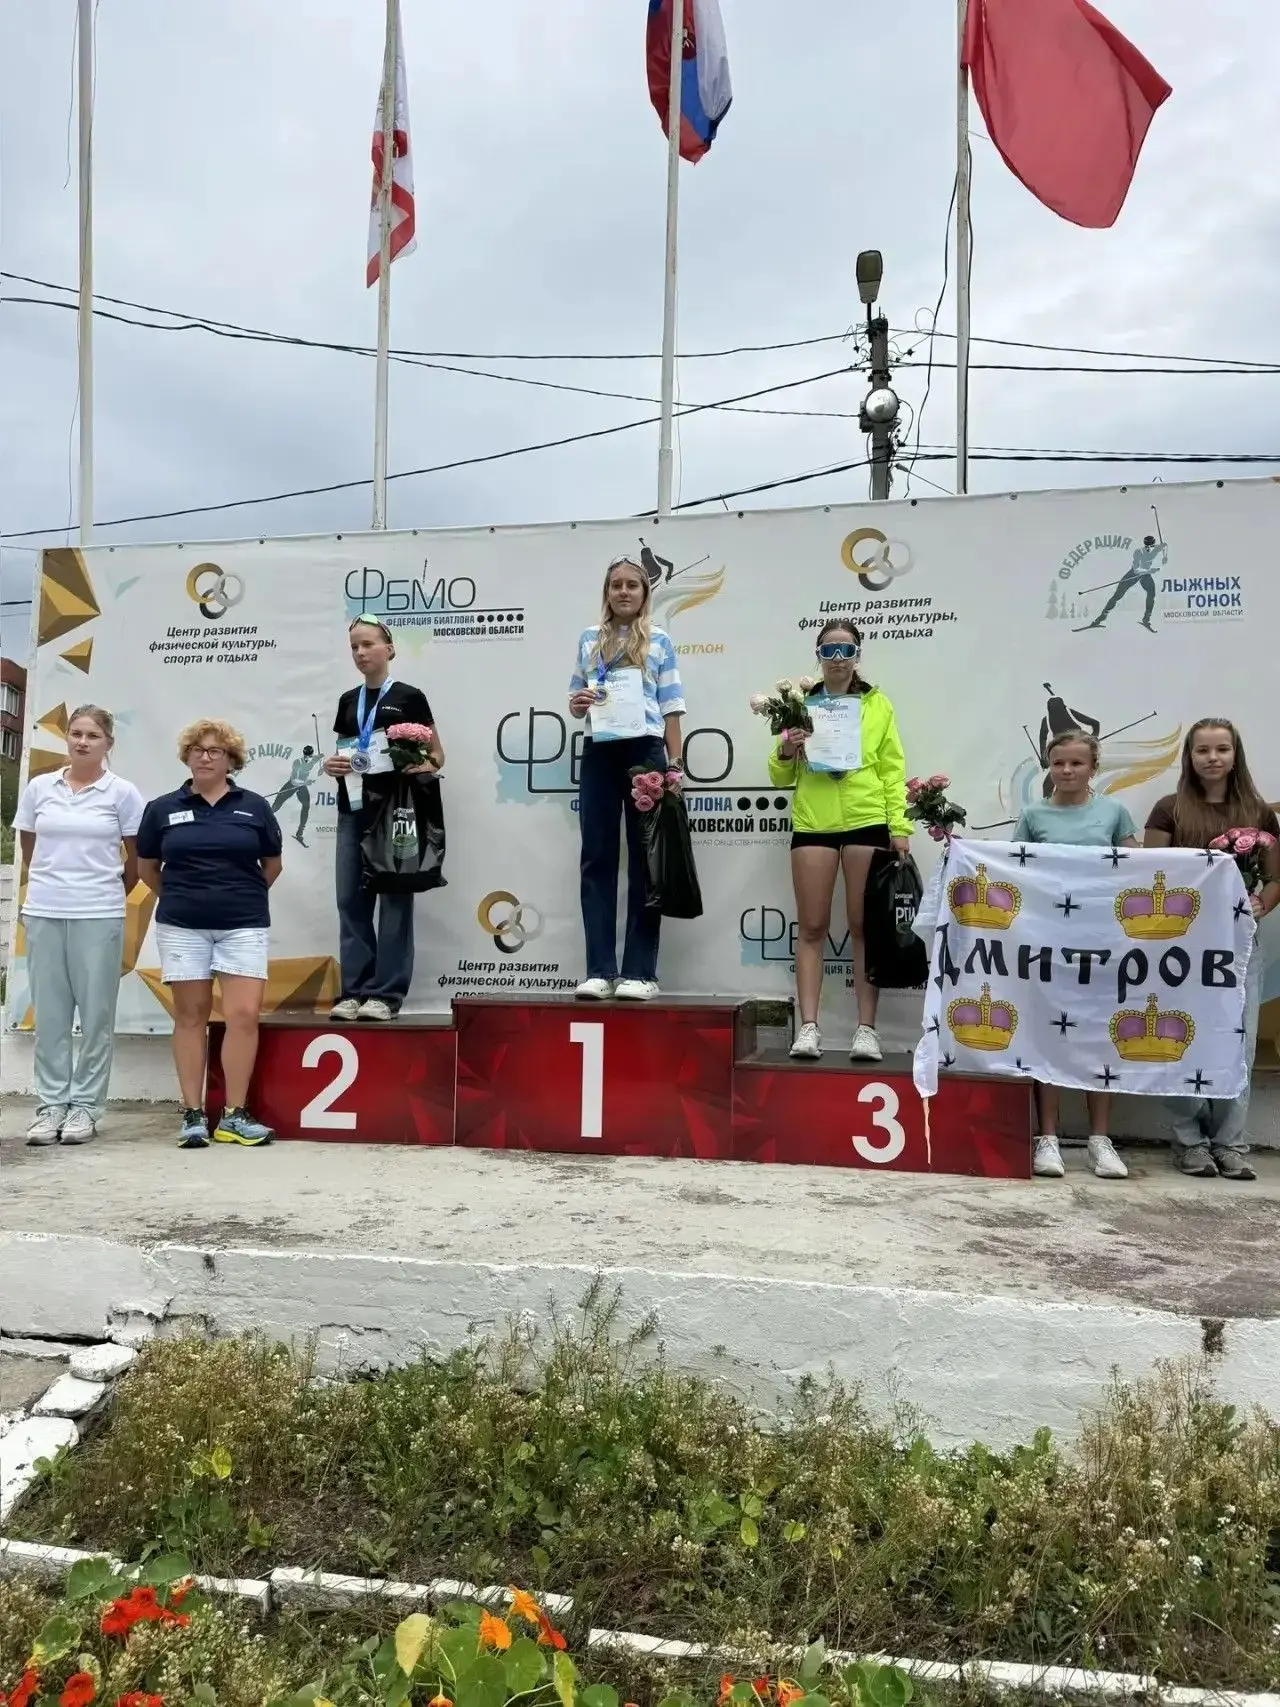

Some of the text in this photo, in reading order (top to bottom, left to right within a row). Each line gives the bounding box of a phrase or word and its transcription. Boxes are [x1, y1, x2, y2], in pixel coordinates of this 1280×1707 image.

[1058, 534, 1133, 580] ФЕДЕРАЦИЯ
[345, 567, 477, 613] ФБМО
[1161, 576, 1241, 593] ЛЫЖНЫХ
[819, 597, 932, 612] Центр развития
[1188, 593, 1241, 608] ГОНОК
[386, 615, 475, 627] ФЕДЕРАЦИЯ БИАТЛОНА
[887, 611, 958, 626] культуры,
[1164, 610, 1209, 619] МОСКОВСКОЙ
[167, 625, 258, 638] Центр развития
[433, 624, 524, 637] МОСКОВСКОЙ ОБЛАСТИ
[869, 631, 878, 640] и
[882, 628, 933, 640] отдыха
[149, 639, 277, 652] физической культуры,
[674, 643, 724, 655] иатлон
[164, 653, 258, 665] спорта и отдыха
[686, 796, 733, 811] ТЛОНА
[392, 820, 417, 839] РТИ
[688, 814, 754, 832] КОВСКОЙ
[458, 960, 559, 974] Центр развития
[438, 974, 516, 987] физической
[299, 1033, 359, 1130] 2
[568, 1022, 604, 1138] 1
[852, 1081, 906, 1165] 3
